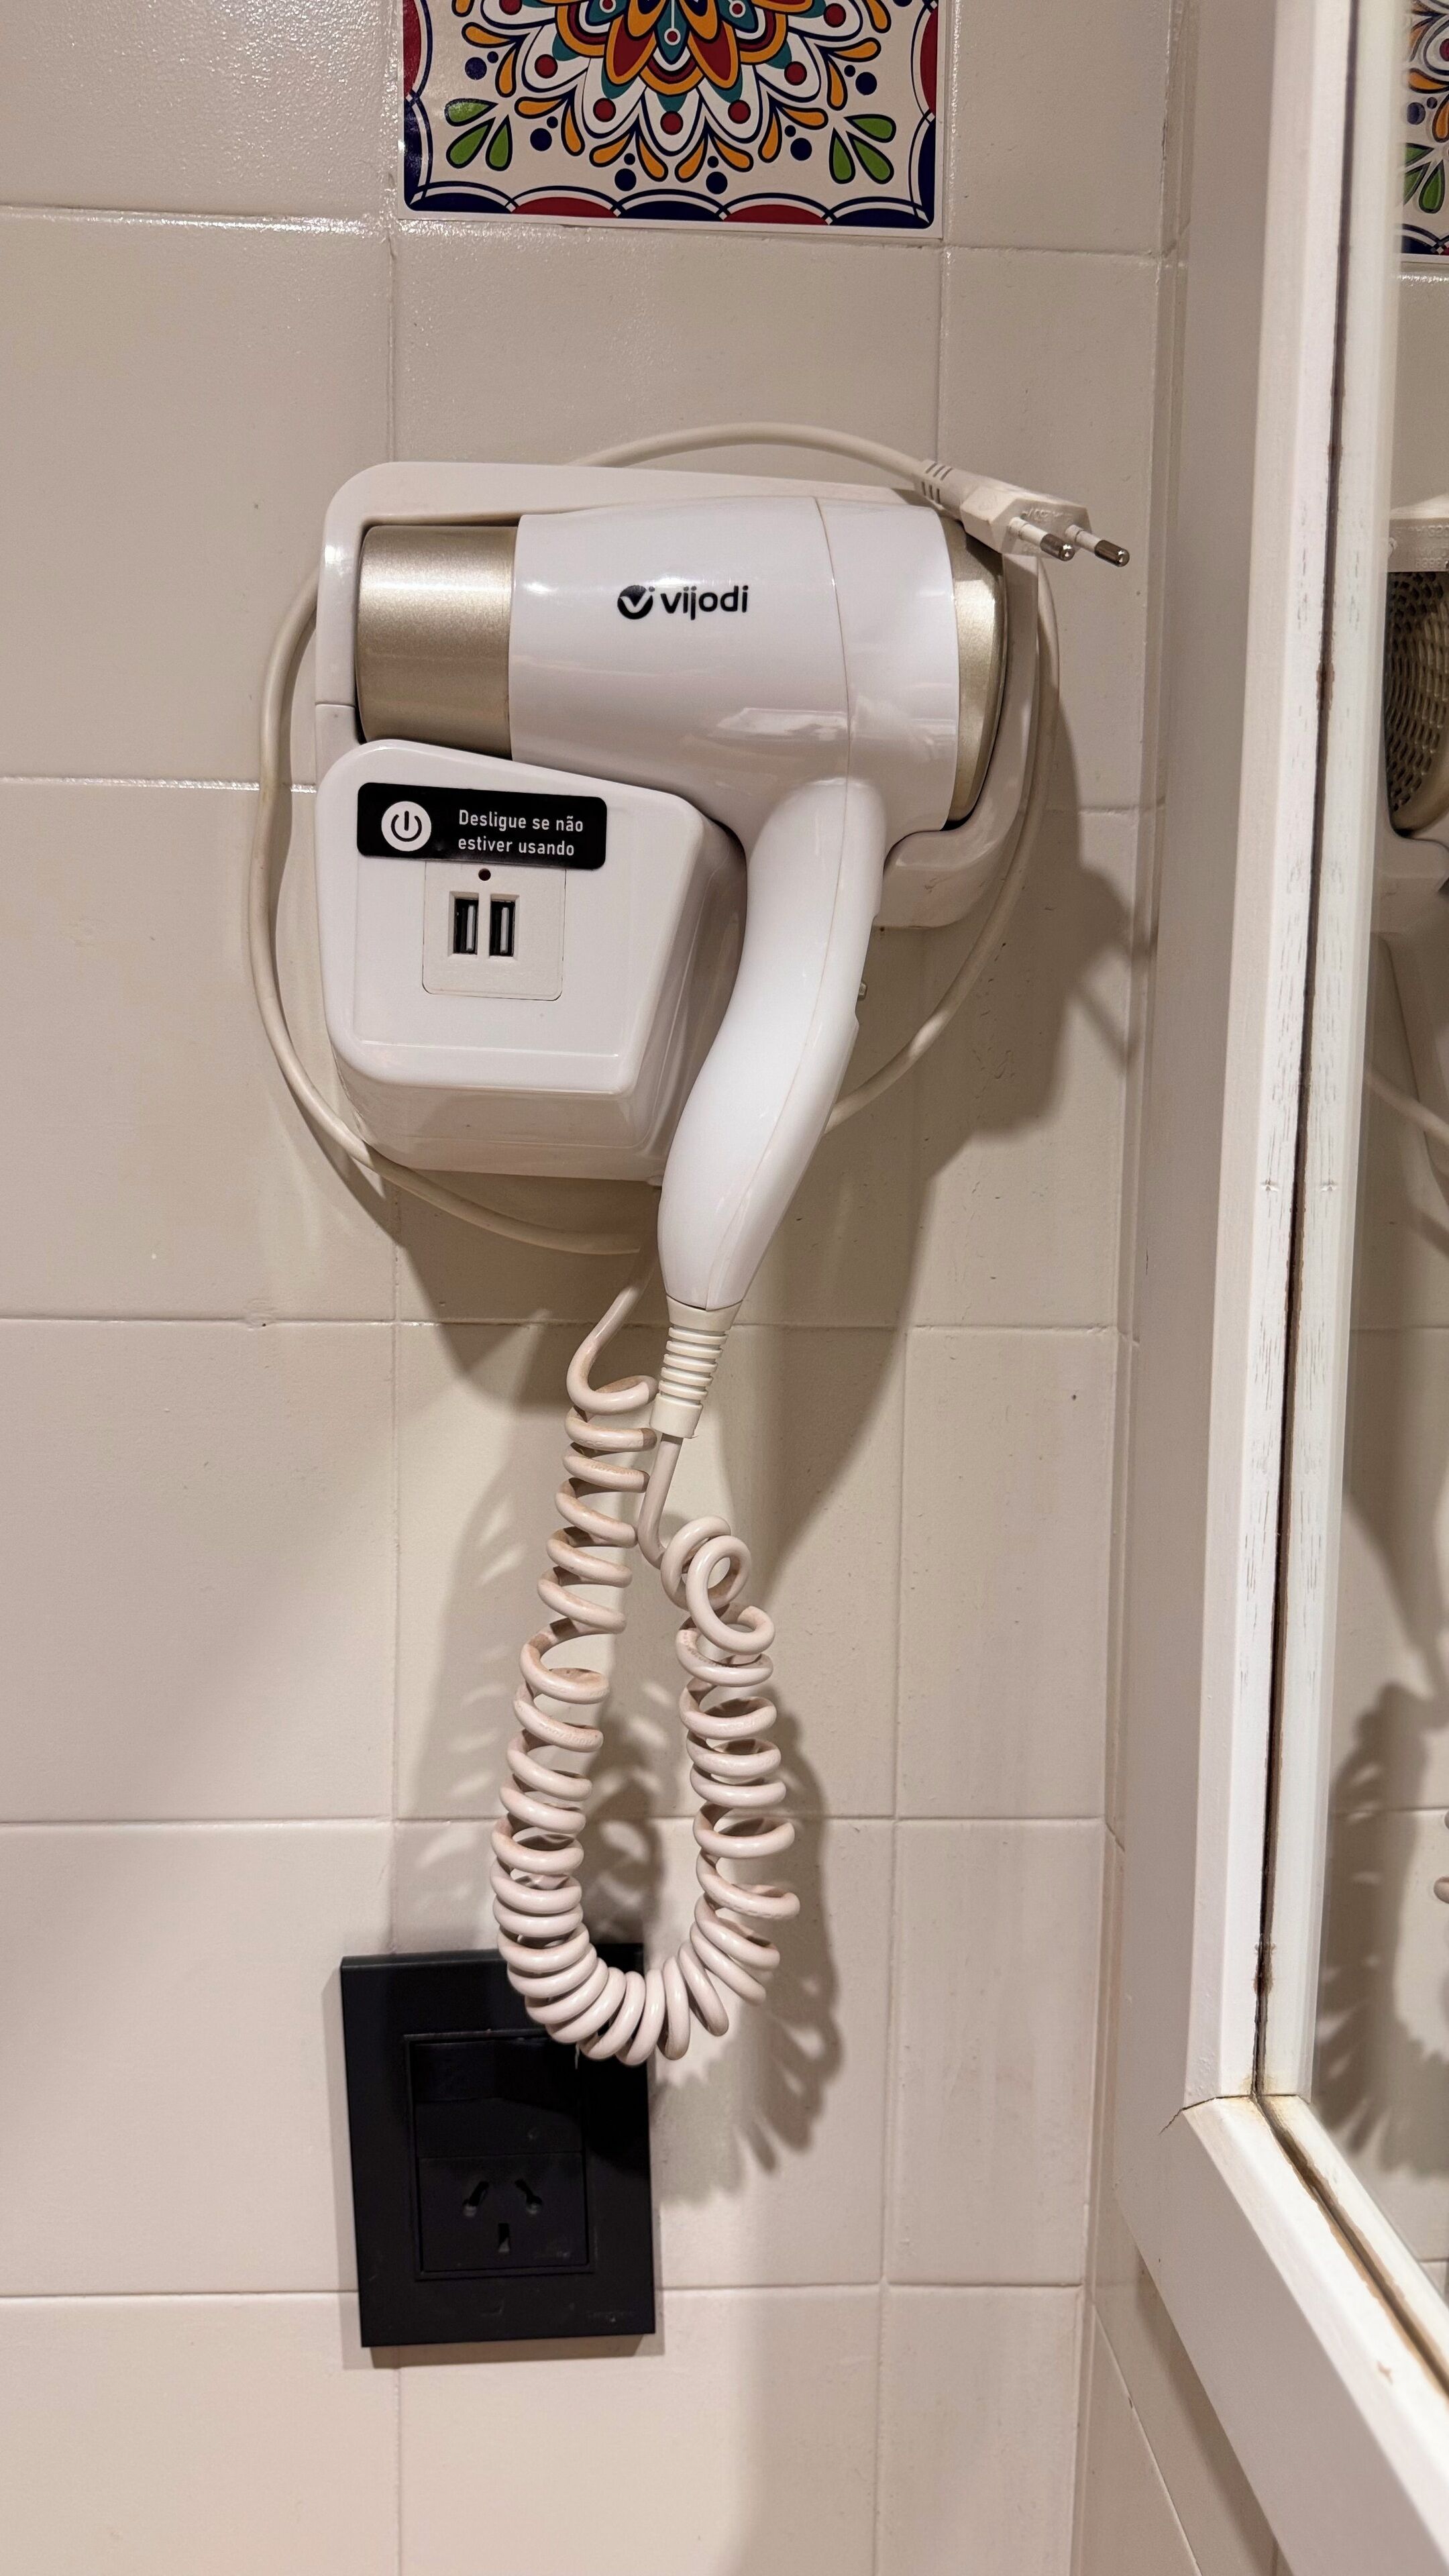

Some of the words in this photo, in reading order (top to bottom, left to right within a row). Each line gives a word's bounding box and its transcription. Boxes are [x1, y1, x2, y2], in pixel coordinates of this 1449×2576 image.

[659, 585, 749, 621] vijodi
[459, 809, 527, 831] Desligue
[532, 818, 550, 830] se
[555, 815, 584, 833] não
[458, 835, 513, 852] estiver
[519, 840, 575, 856] usando
